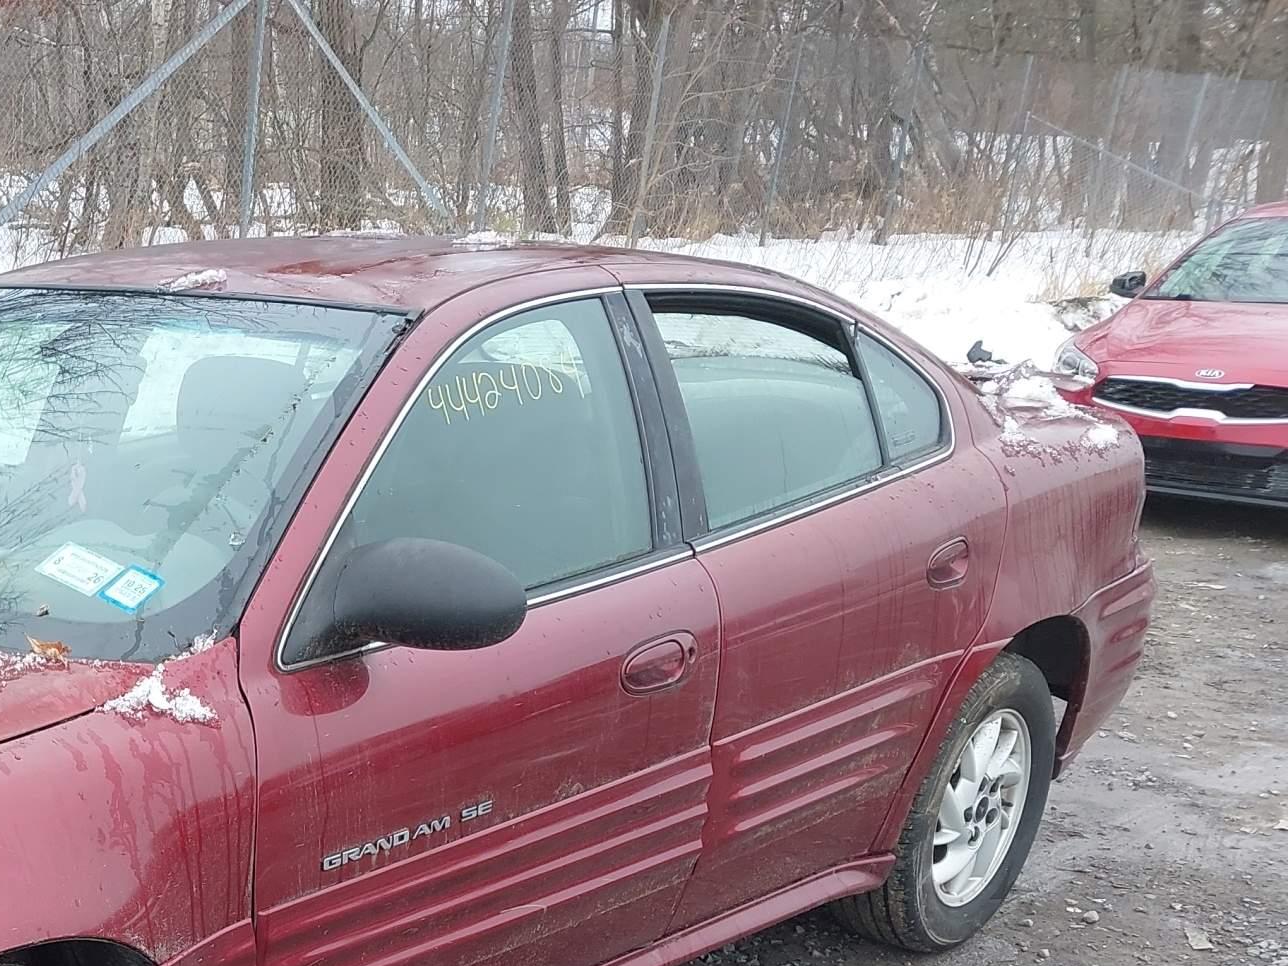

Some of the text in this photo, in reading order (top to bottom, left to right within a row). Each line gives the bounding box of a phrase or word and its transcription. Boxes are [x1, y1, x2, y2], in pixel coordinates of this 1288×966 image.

[428, 343, 585, 425] 44424084
[1197, 368, 1222, 378] KIA
[322, 800, 494, 871] GRAND AM SE
